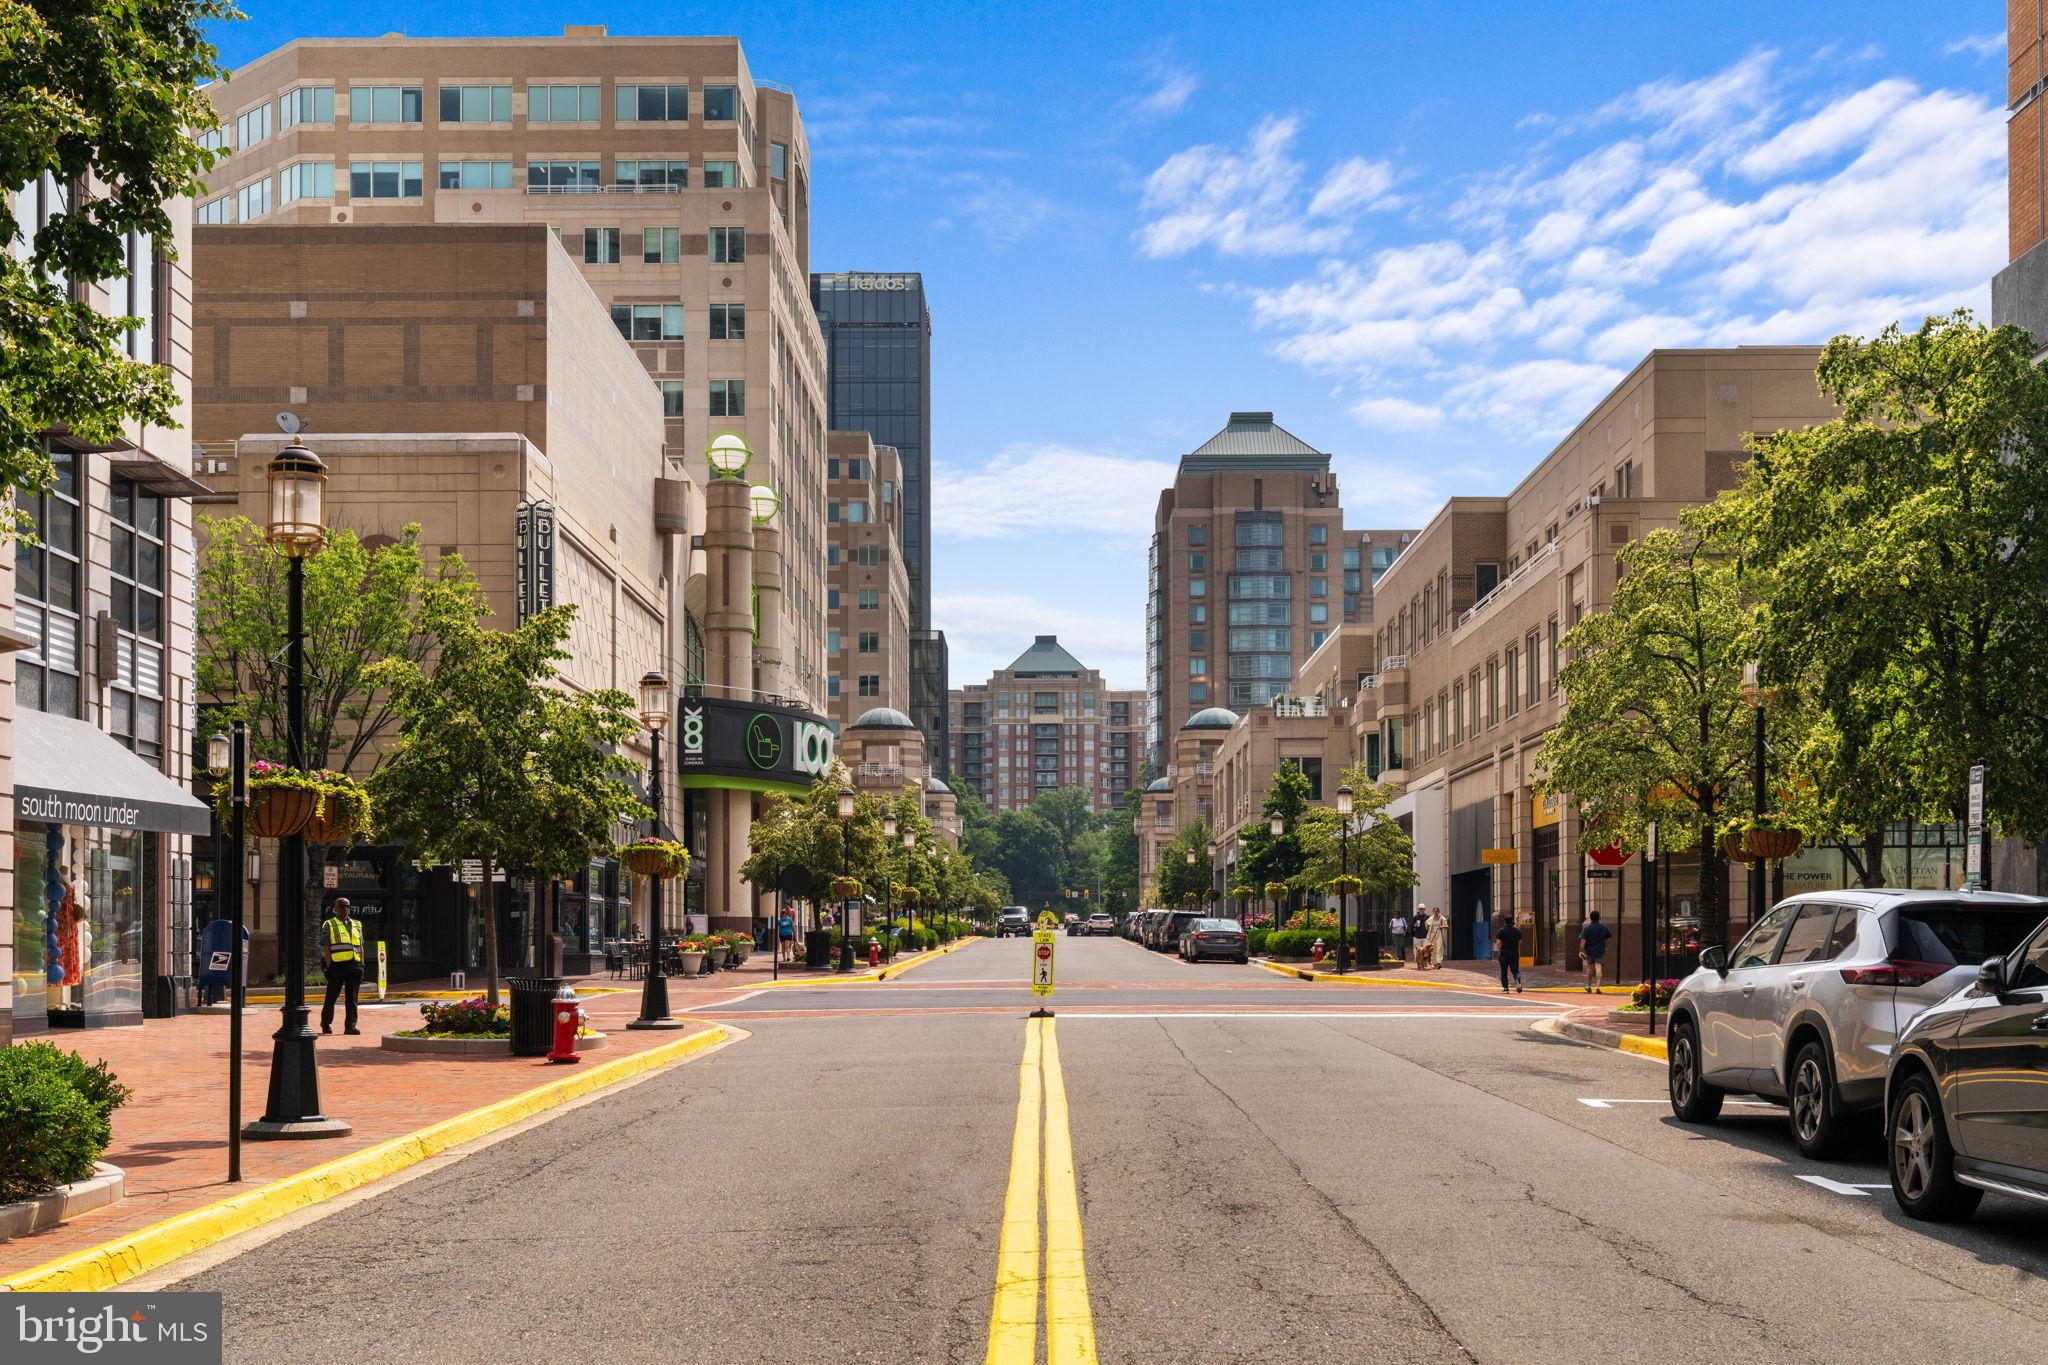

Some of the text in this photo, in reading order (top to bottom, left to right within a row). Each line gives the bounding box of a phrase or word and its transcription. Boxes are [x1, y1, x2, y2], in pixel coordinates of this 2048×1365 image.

[855, 274, 905, 291] leidos
[684, 706, 704, 754] LOOK
[793, 721, 834, 778] LOO
[21, 794, 139, 826] south moon under
[1797, 872, 1832, 880] POWER
